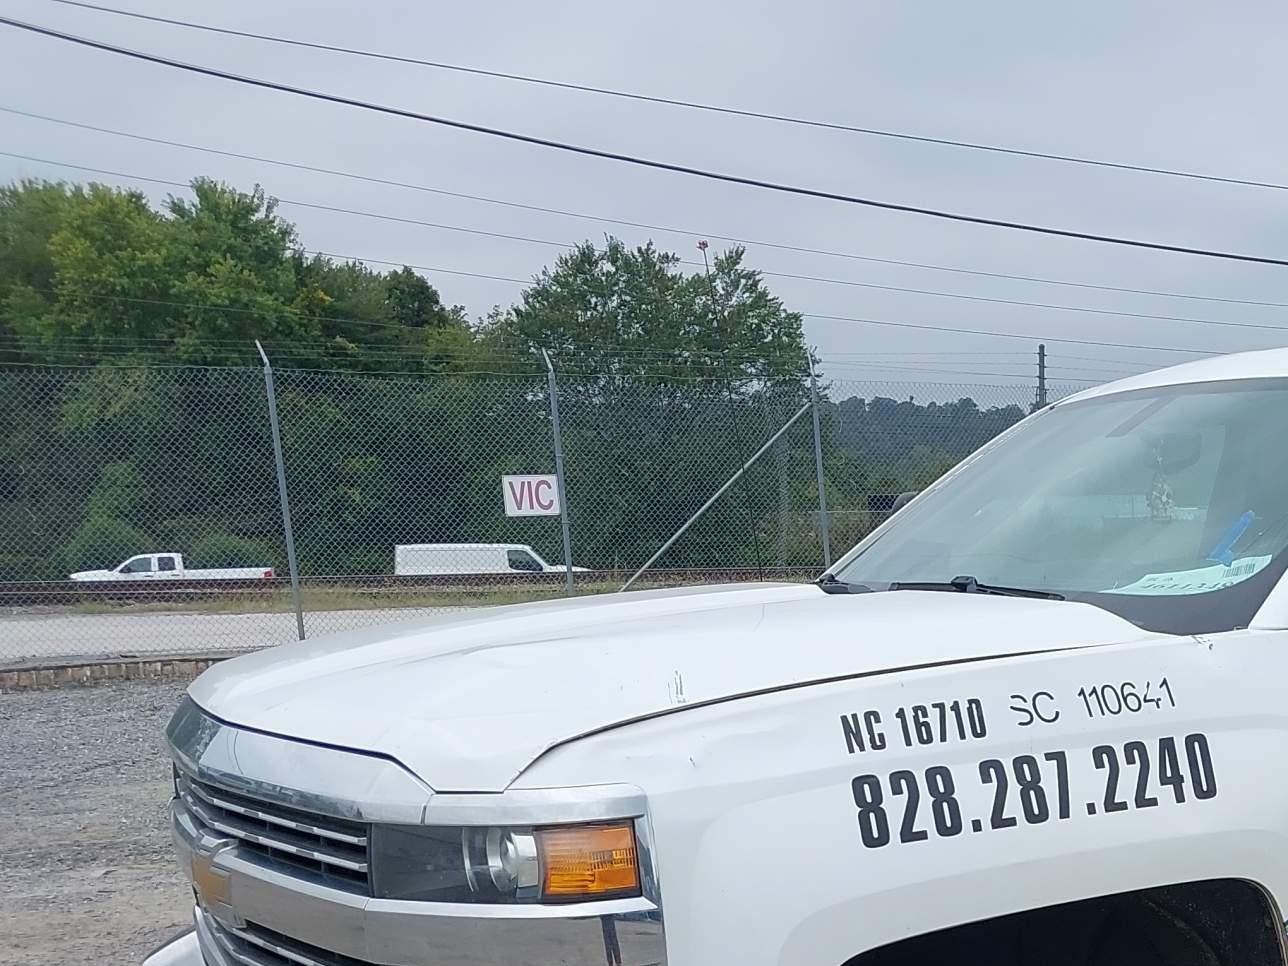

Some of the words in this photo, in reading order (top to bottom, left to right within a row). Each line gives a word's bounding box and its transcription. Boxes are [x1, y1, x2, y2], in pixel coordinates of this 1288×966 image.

[508, 480, 554, 511] VIC
[840, 710, 887, 754] NC
[895, 698, 987, 747] 16710
[1009, 691, 1060, 727] SC
[1077, 677, 1177, 718] 110641
[851, 733, 1218, 849] 828.287.2240
